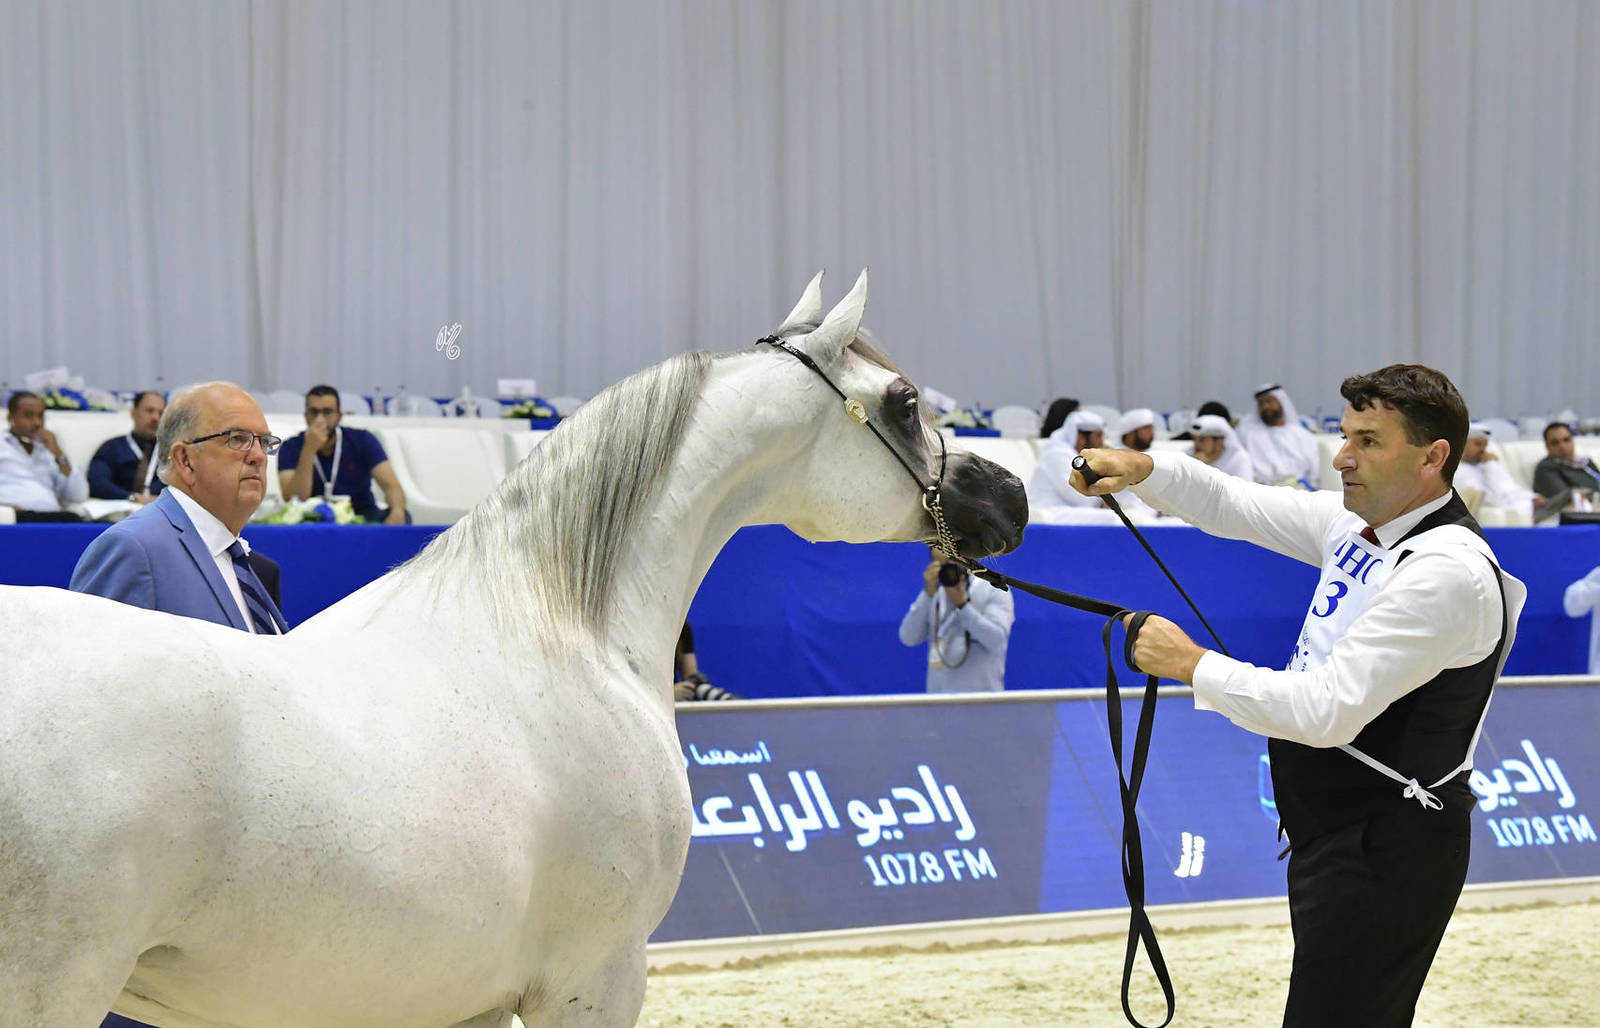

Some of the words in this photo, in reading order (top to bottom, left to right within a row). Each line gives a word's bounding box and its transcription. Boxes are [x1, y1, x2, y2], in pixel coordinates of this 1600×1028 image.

[1311, 580, 1349, 618] 3
[1468, 739, 1577, 813] راديو
[847, 764, 977, 848] راديو
[1486, 815, 1555, 848] 107.8
[1551, 813, 1598, 844] FM
[864, 851, 946, 887] 107.8
[943, 847, 999, 882] FM
